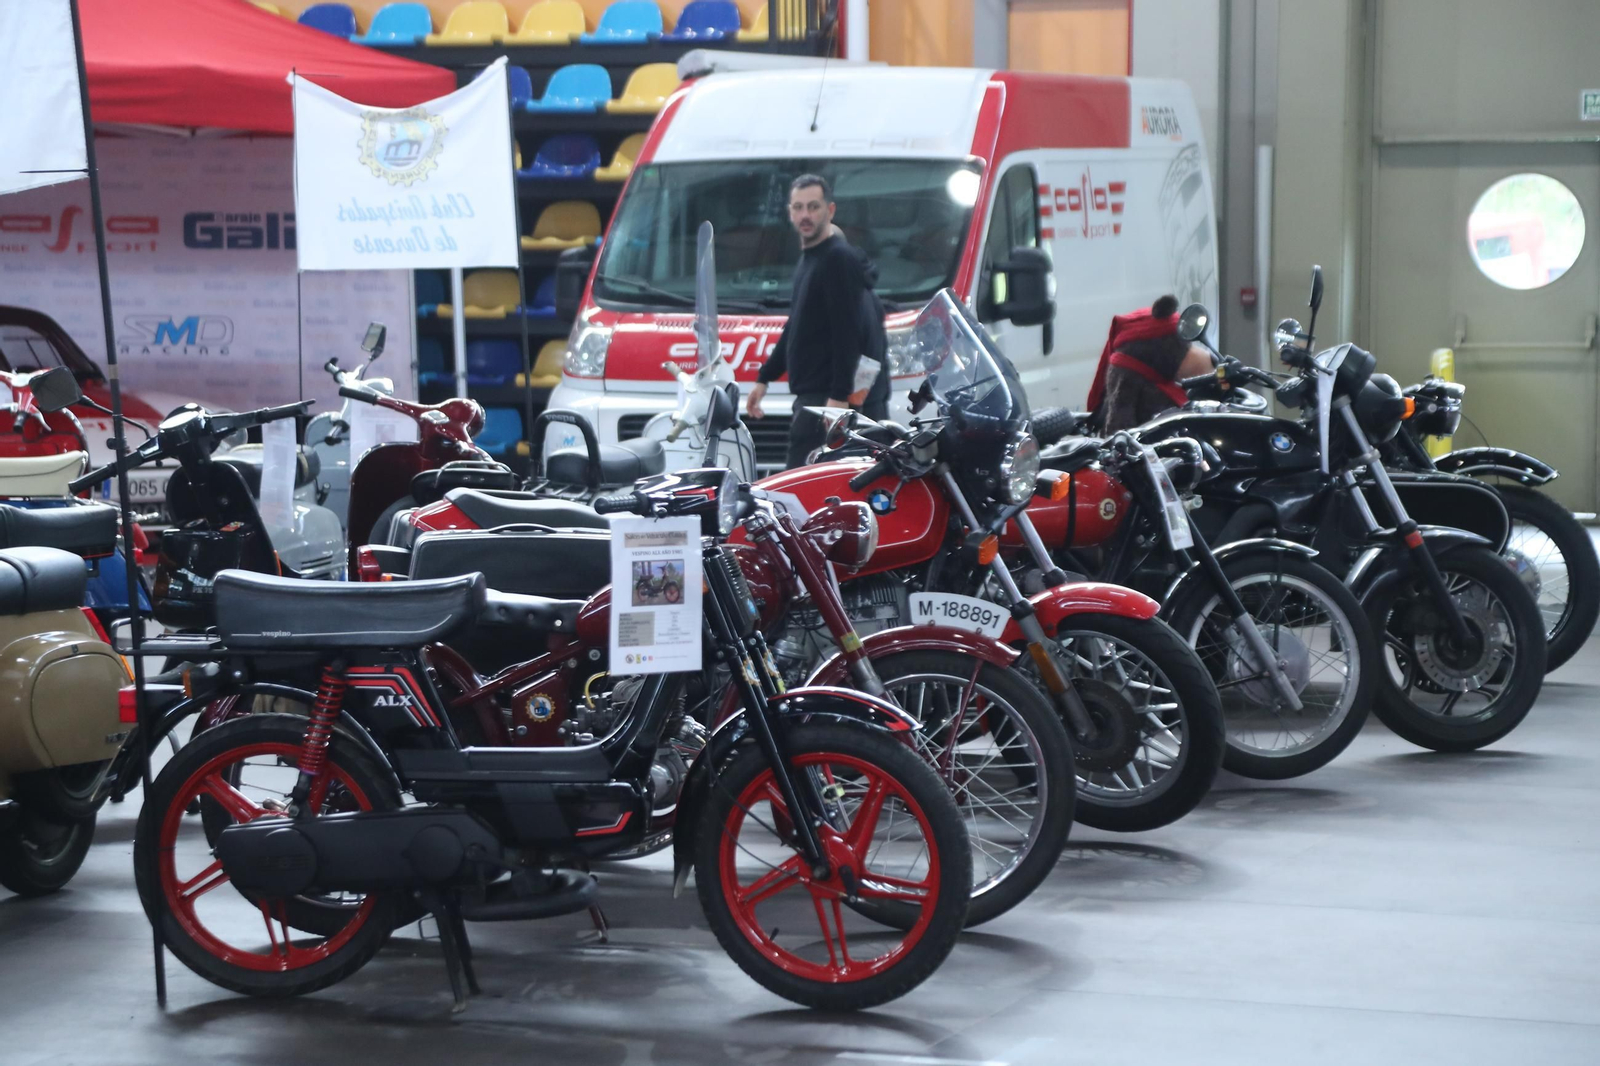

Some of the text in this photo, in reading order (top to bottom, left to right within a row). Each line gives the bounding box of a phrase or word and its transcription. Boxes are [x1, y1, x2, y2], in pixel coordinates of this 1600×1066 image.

[184, 212, 295, 250] Gali
[129, 479, 157, 496] 065
[373, 695, 413, 707] ALX
